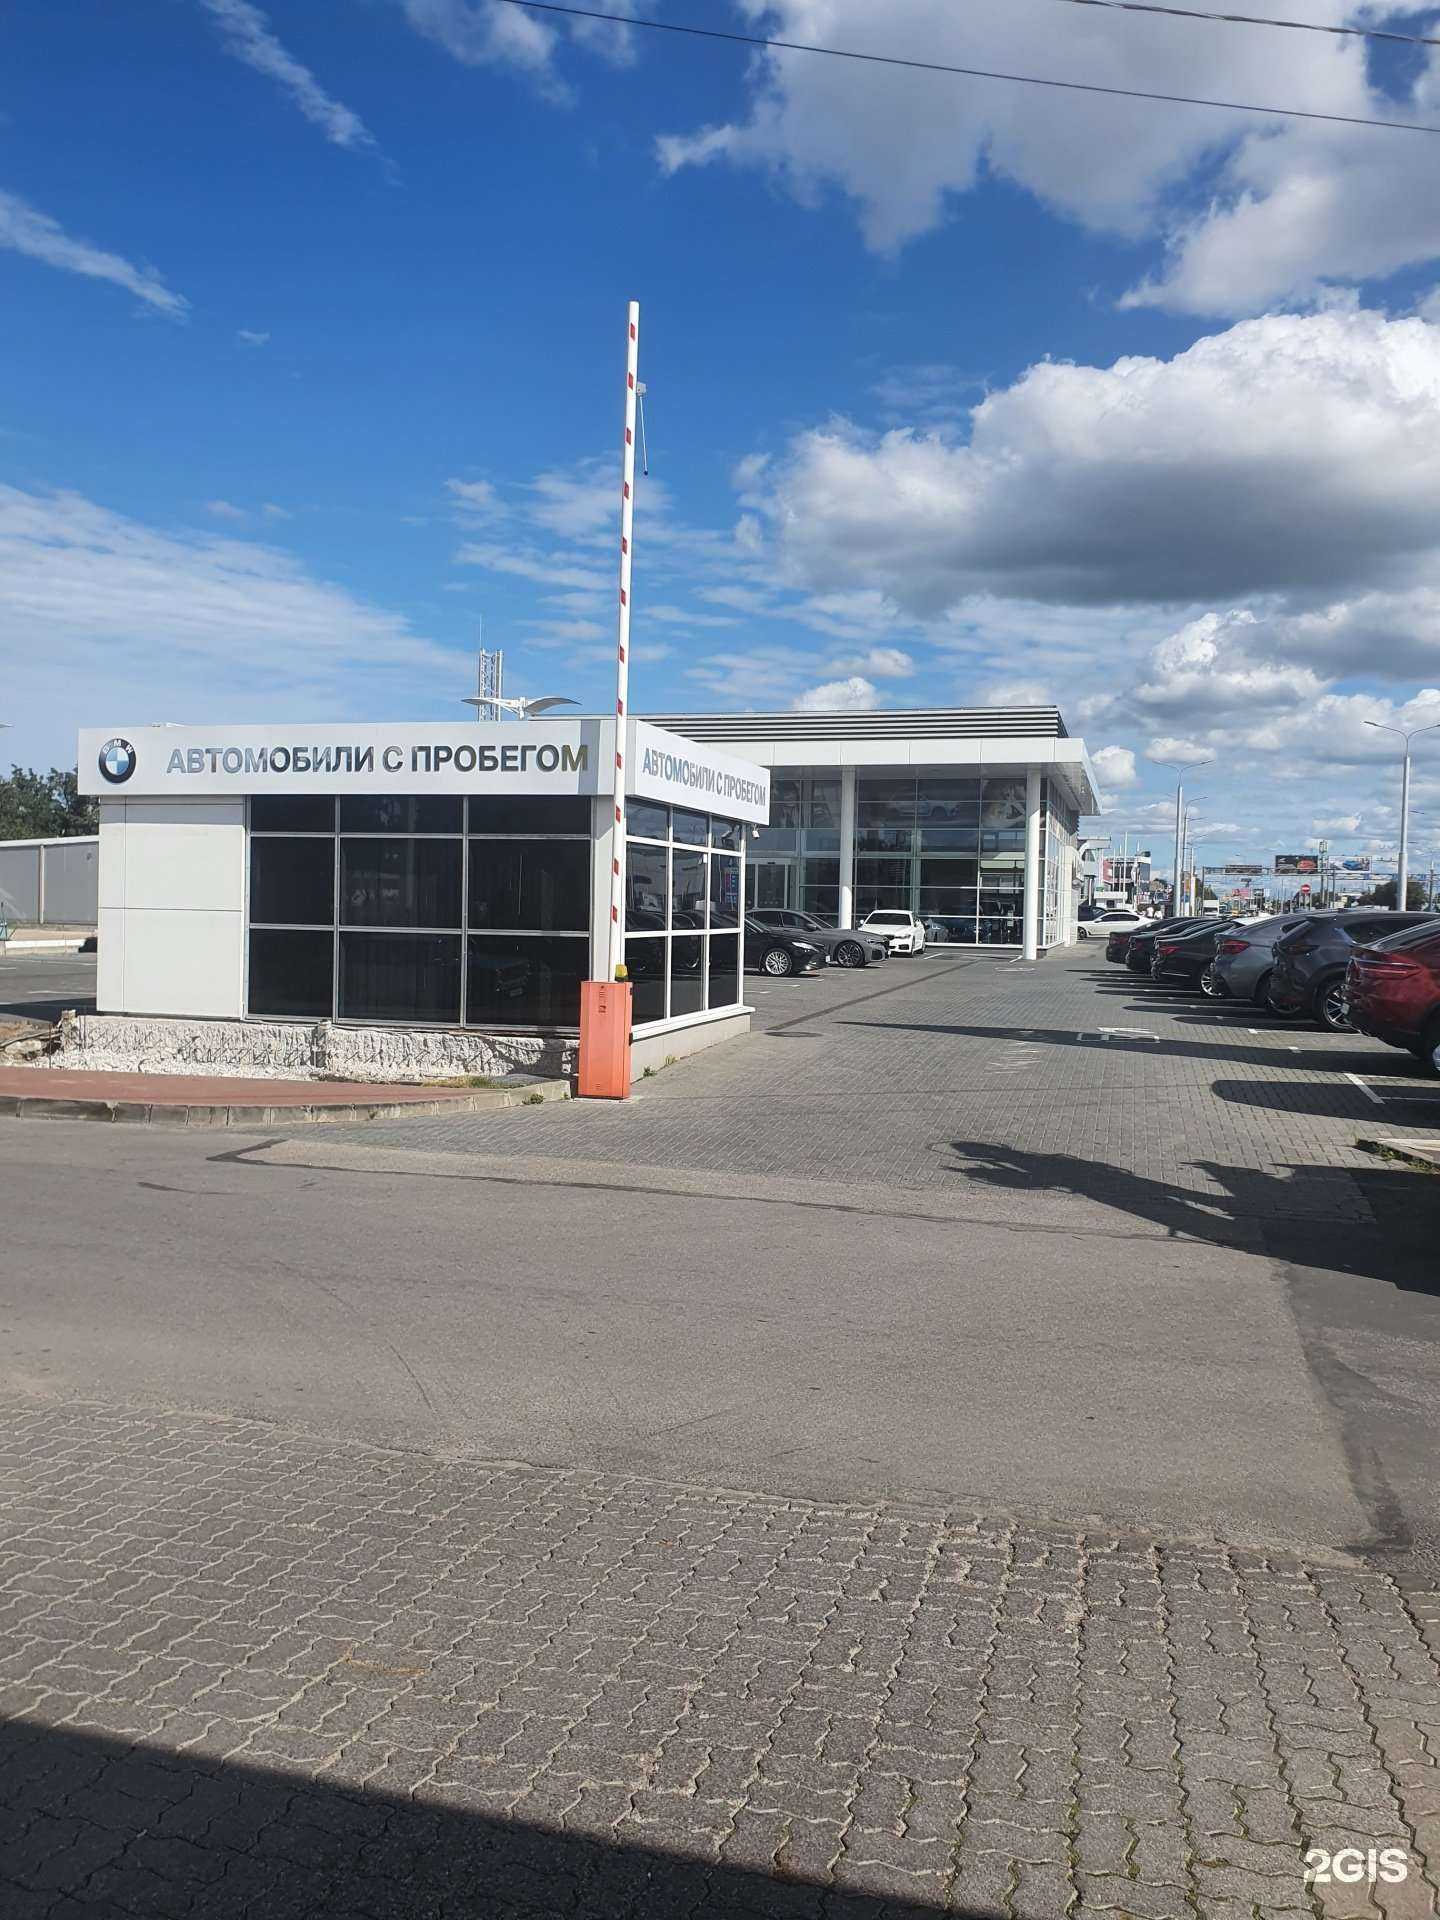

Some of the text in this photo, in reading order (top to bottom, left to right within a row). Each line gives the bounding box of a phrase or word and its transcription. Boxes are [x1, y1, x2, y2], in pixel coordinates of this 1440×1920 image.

[166, 744, 588, 774] АВТОМОБИЛИ С ПРОБЕГОМ
[642, 747, 766, 806] АВТОМОБИЛИ С ПРОБЕГОМ
